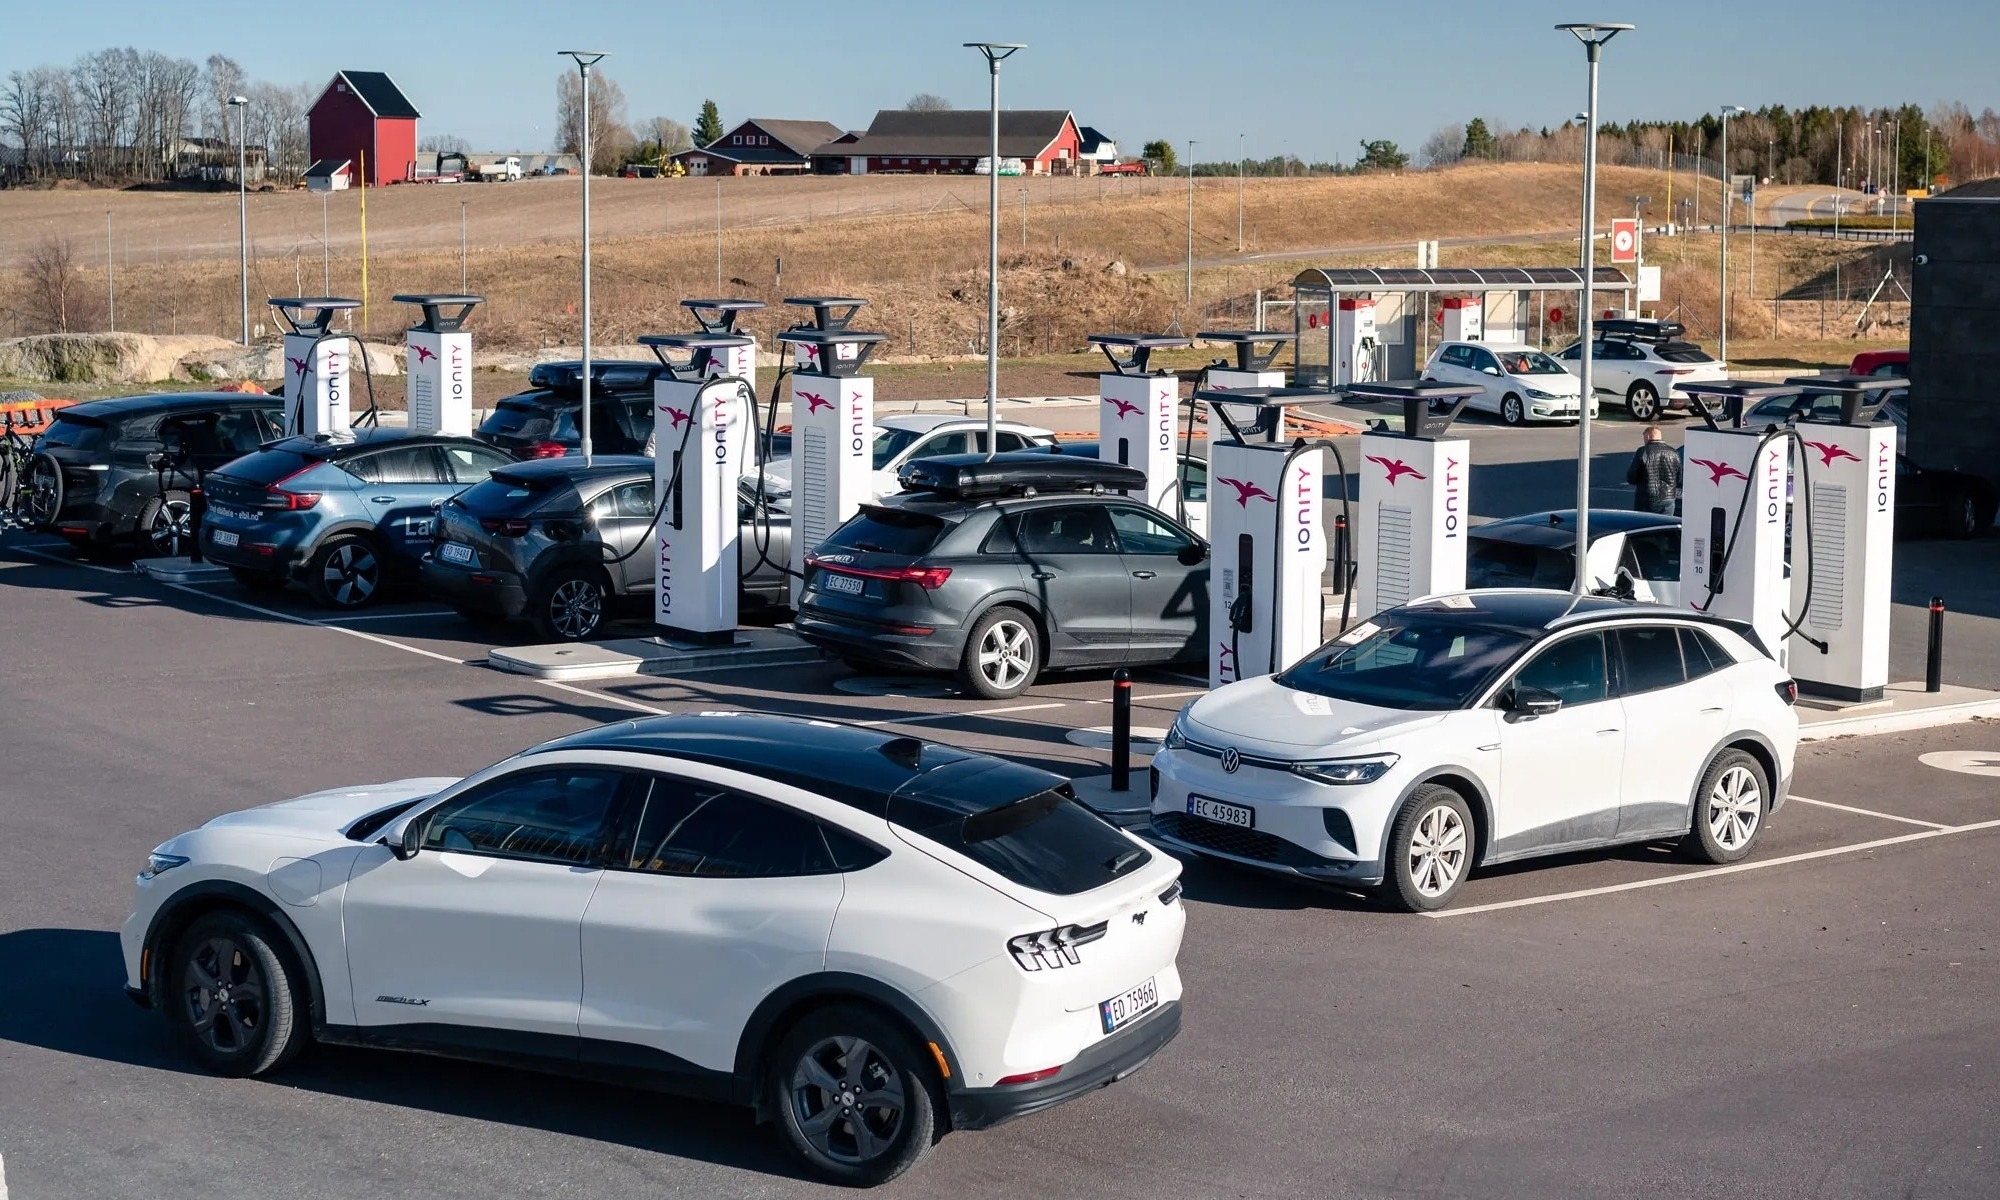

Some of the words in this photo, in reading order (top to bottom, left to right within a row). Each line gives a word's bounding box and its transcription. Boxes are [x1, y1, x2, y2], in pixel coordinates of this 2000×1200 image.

[329, 349, 340, 407] IONITY
[452, 344, 463, 400] IONITY
[715, 397, 727, 465] IONITY
[852, 391, 864, 456] IONITY
[1159, 390, 1170, 452] IONITY
[1446, 456, 1459, 538] IONITY
[1768, 450, 1780, 524] IONITY
[1878, 442, 1889, 513] IONITY
[1298, 467, 1311, 552] IONITY
[661, 538, 671, 614] IONITY
[830, 576, 840, 588] EC
[839, 578, 861, 592] 27550
[1695, 566, 1703, 574] 10
[1224, 600, 1232, 610] 12
[1196, 800, 1208, 816] EC
[1212, 805, 1247, 825] 45983
[1112, 1000, 1125, 1021] ED
[1127, 981, 1155, 1013] 75966
